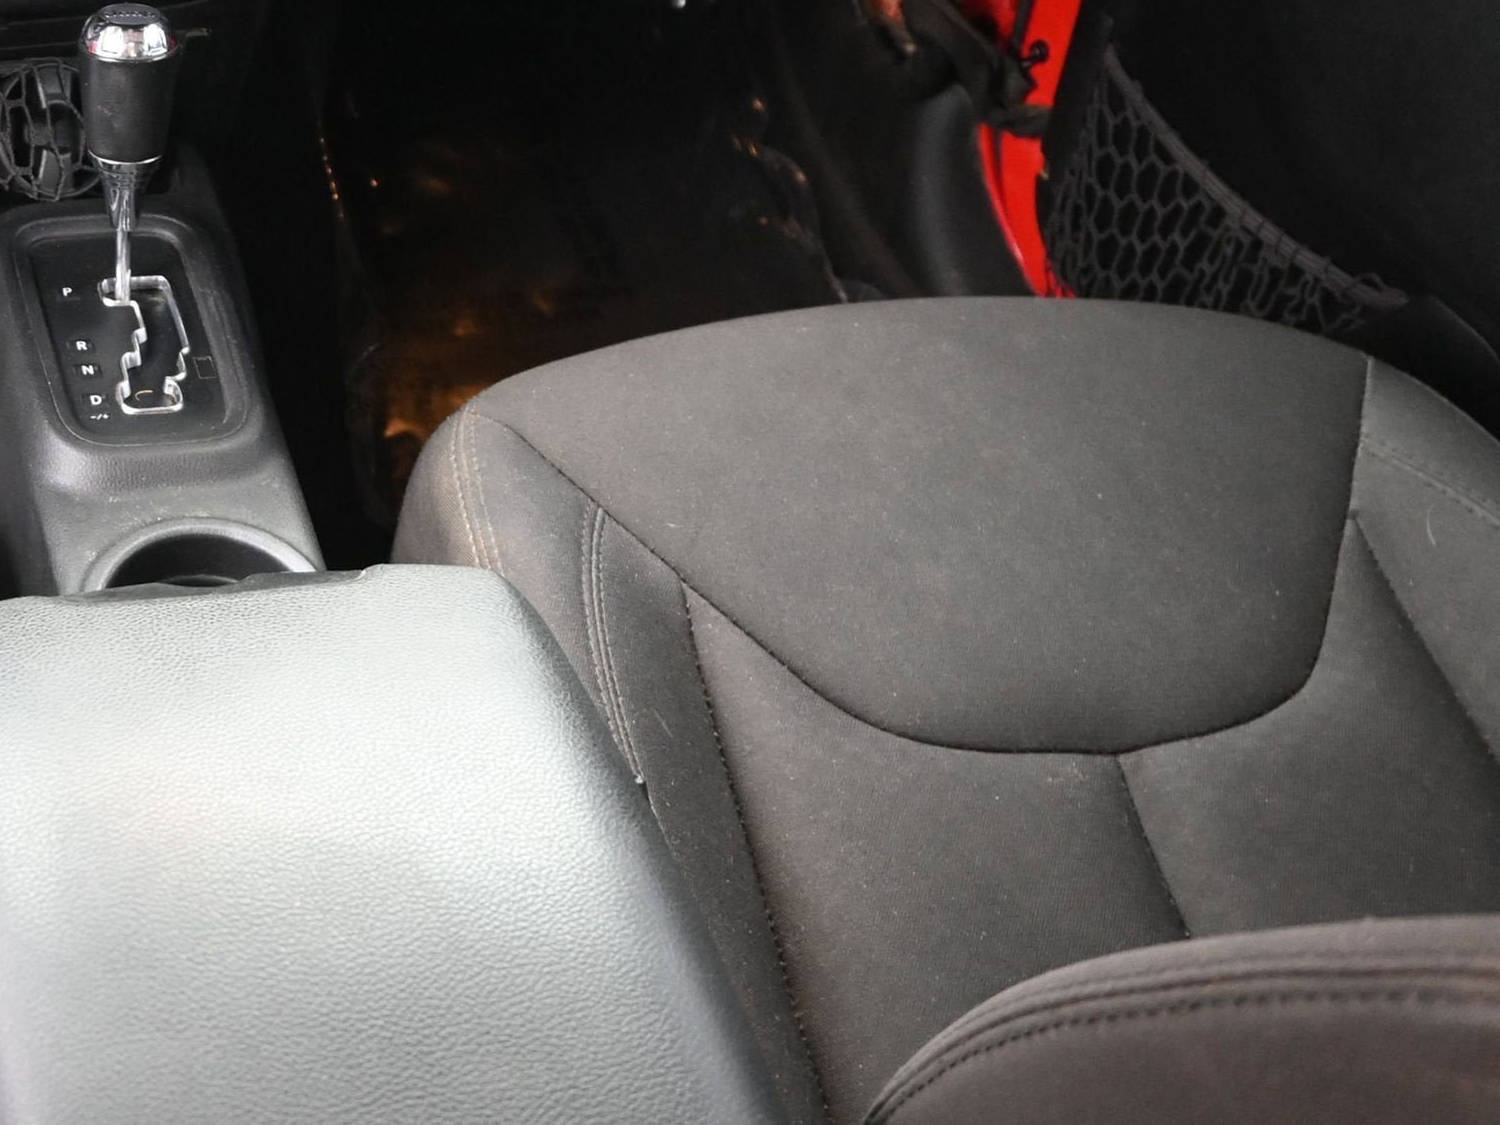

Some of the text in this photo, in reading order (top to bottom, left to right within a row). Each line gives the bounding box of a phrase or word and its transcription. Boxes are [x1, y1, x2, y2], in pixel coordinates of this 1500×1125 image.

[62, 287, 73, 296] P
[75, 340, 88, 351] R
[81, 365, 95, 375] N
[90, 394, 102, 406] D
